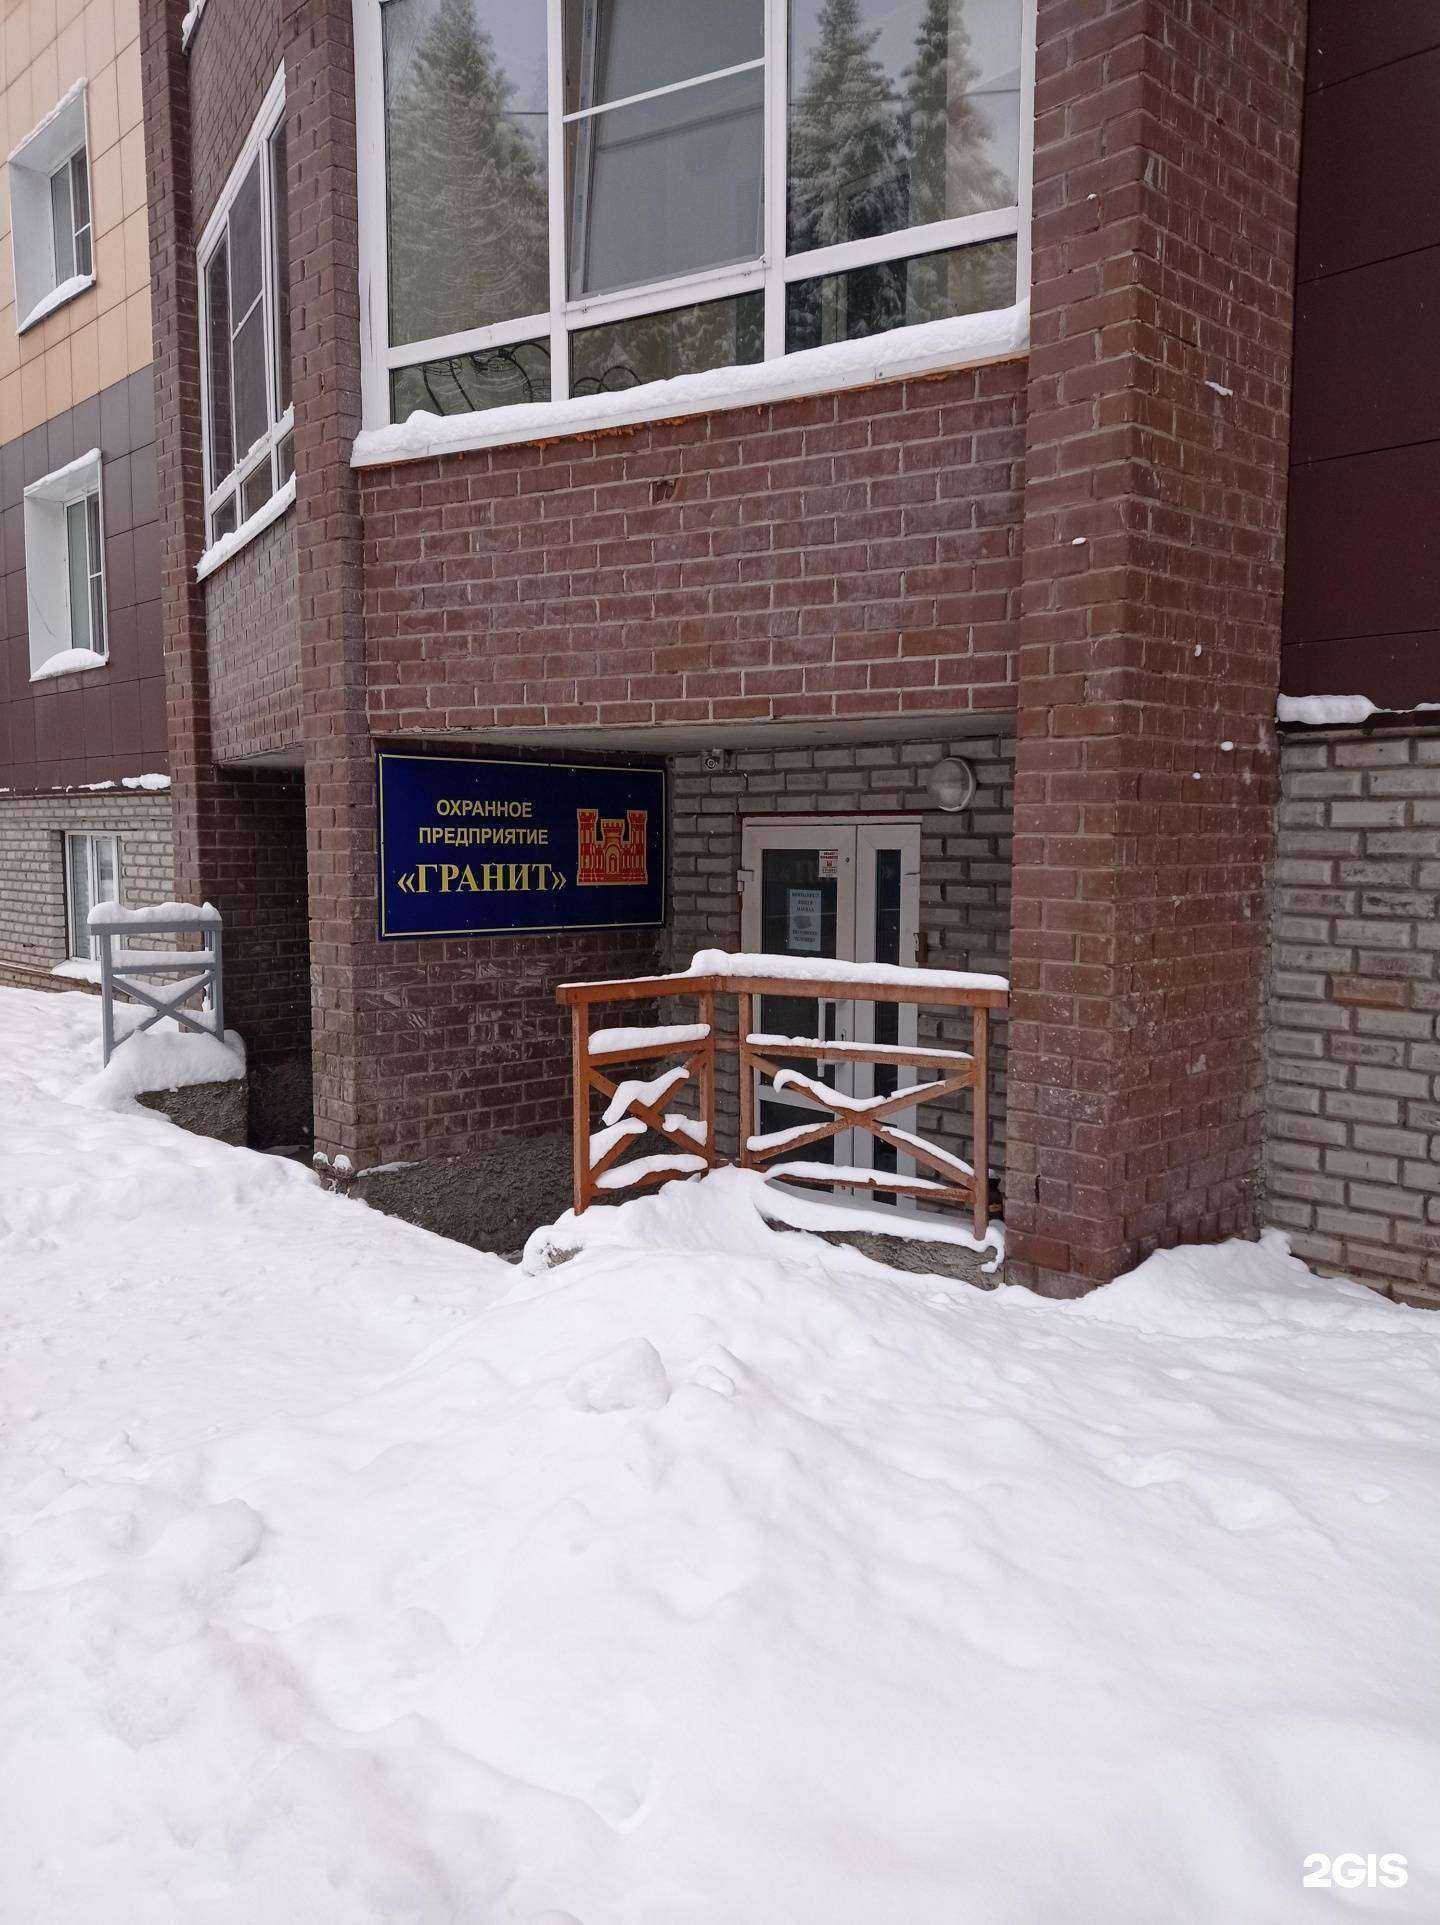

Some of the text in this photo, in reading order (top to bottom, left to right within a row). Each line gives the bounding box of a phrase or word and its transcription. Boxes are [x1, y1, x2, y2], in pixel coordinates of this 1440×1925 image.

[436, 799, 533, 818] ОХРАННОЕ
[419, 827, 549, 847] ПРЕДПРИЯТИЕ
[397, 863, 567, 893] «ГРАНИТ»
